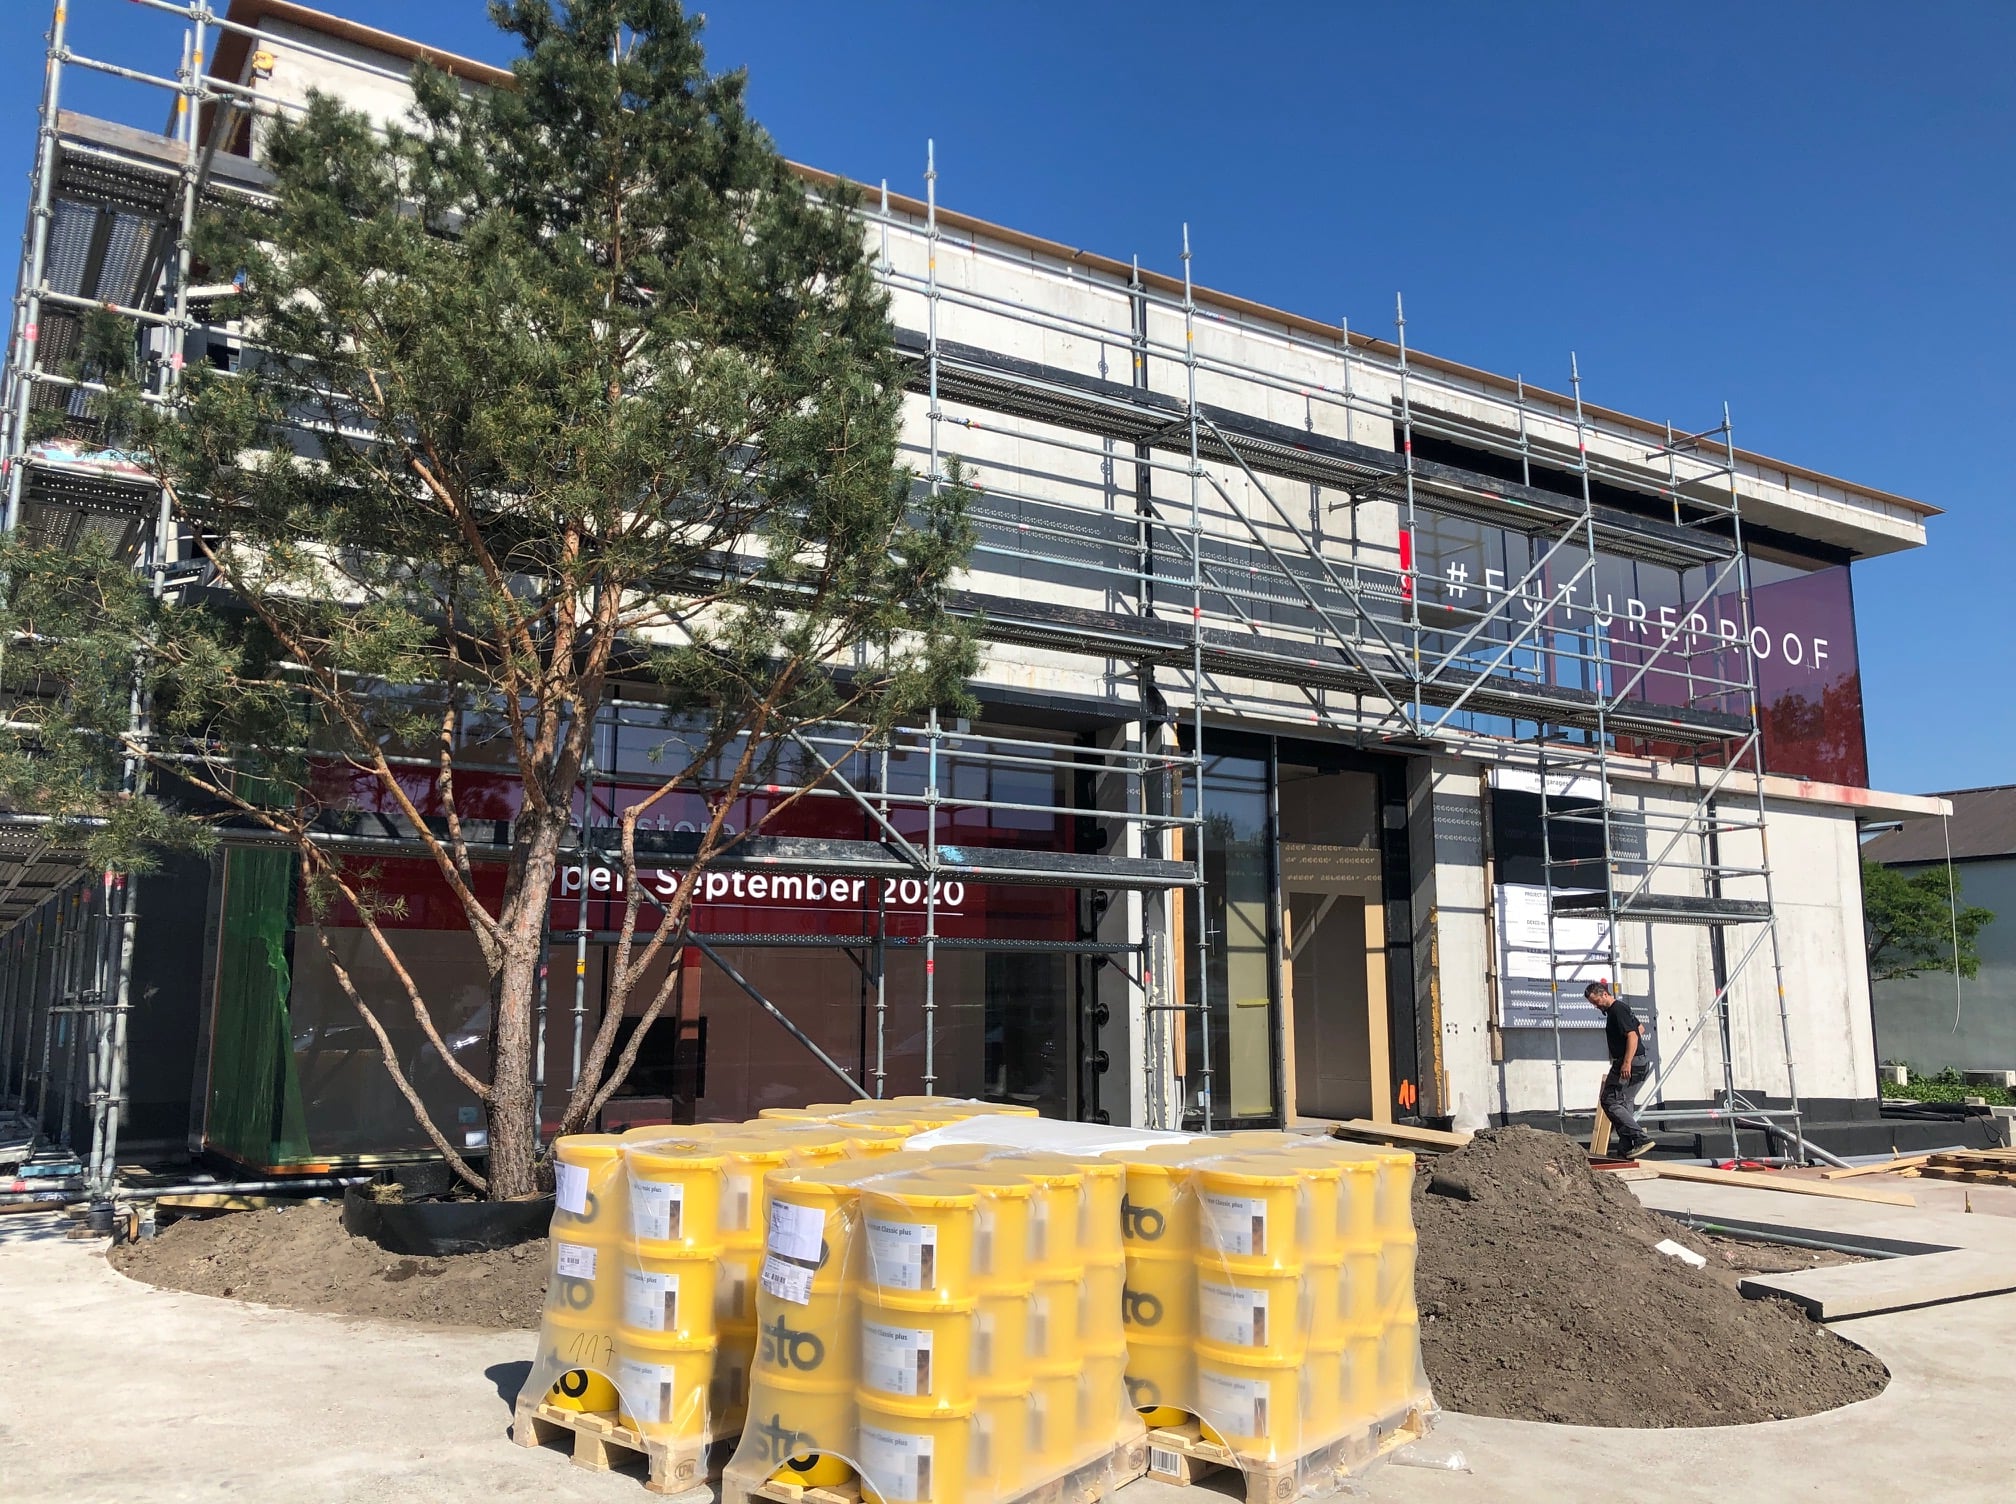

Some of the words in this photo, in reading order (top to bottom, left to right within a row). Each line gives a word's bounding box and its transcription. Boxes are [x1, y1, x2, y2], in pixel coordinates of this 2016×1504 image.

[1446, 561, 1829, 670] #FUTUREPROOF
[654, 867, 866, 904] September
[880, 877, 965, 907] 2020
[881, 1225, 898, 1235] Classic
[898, 1228, 912, 1236] plus
[1121, 1192, 1165, 1241] to
[555, 1278, 595, 1311] to
[568, 1332, 616, 1367] 117
[761, 1314, 825, 1372] sto
[894, 1331, 908, 1341] plus
[756, 1413, 820, 1472] sto
